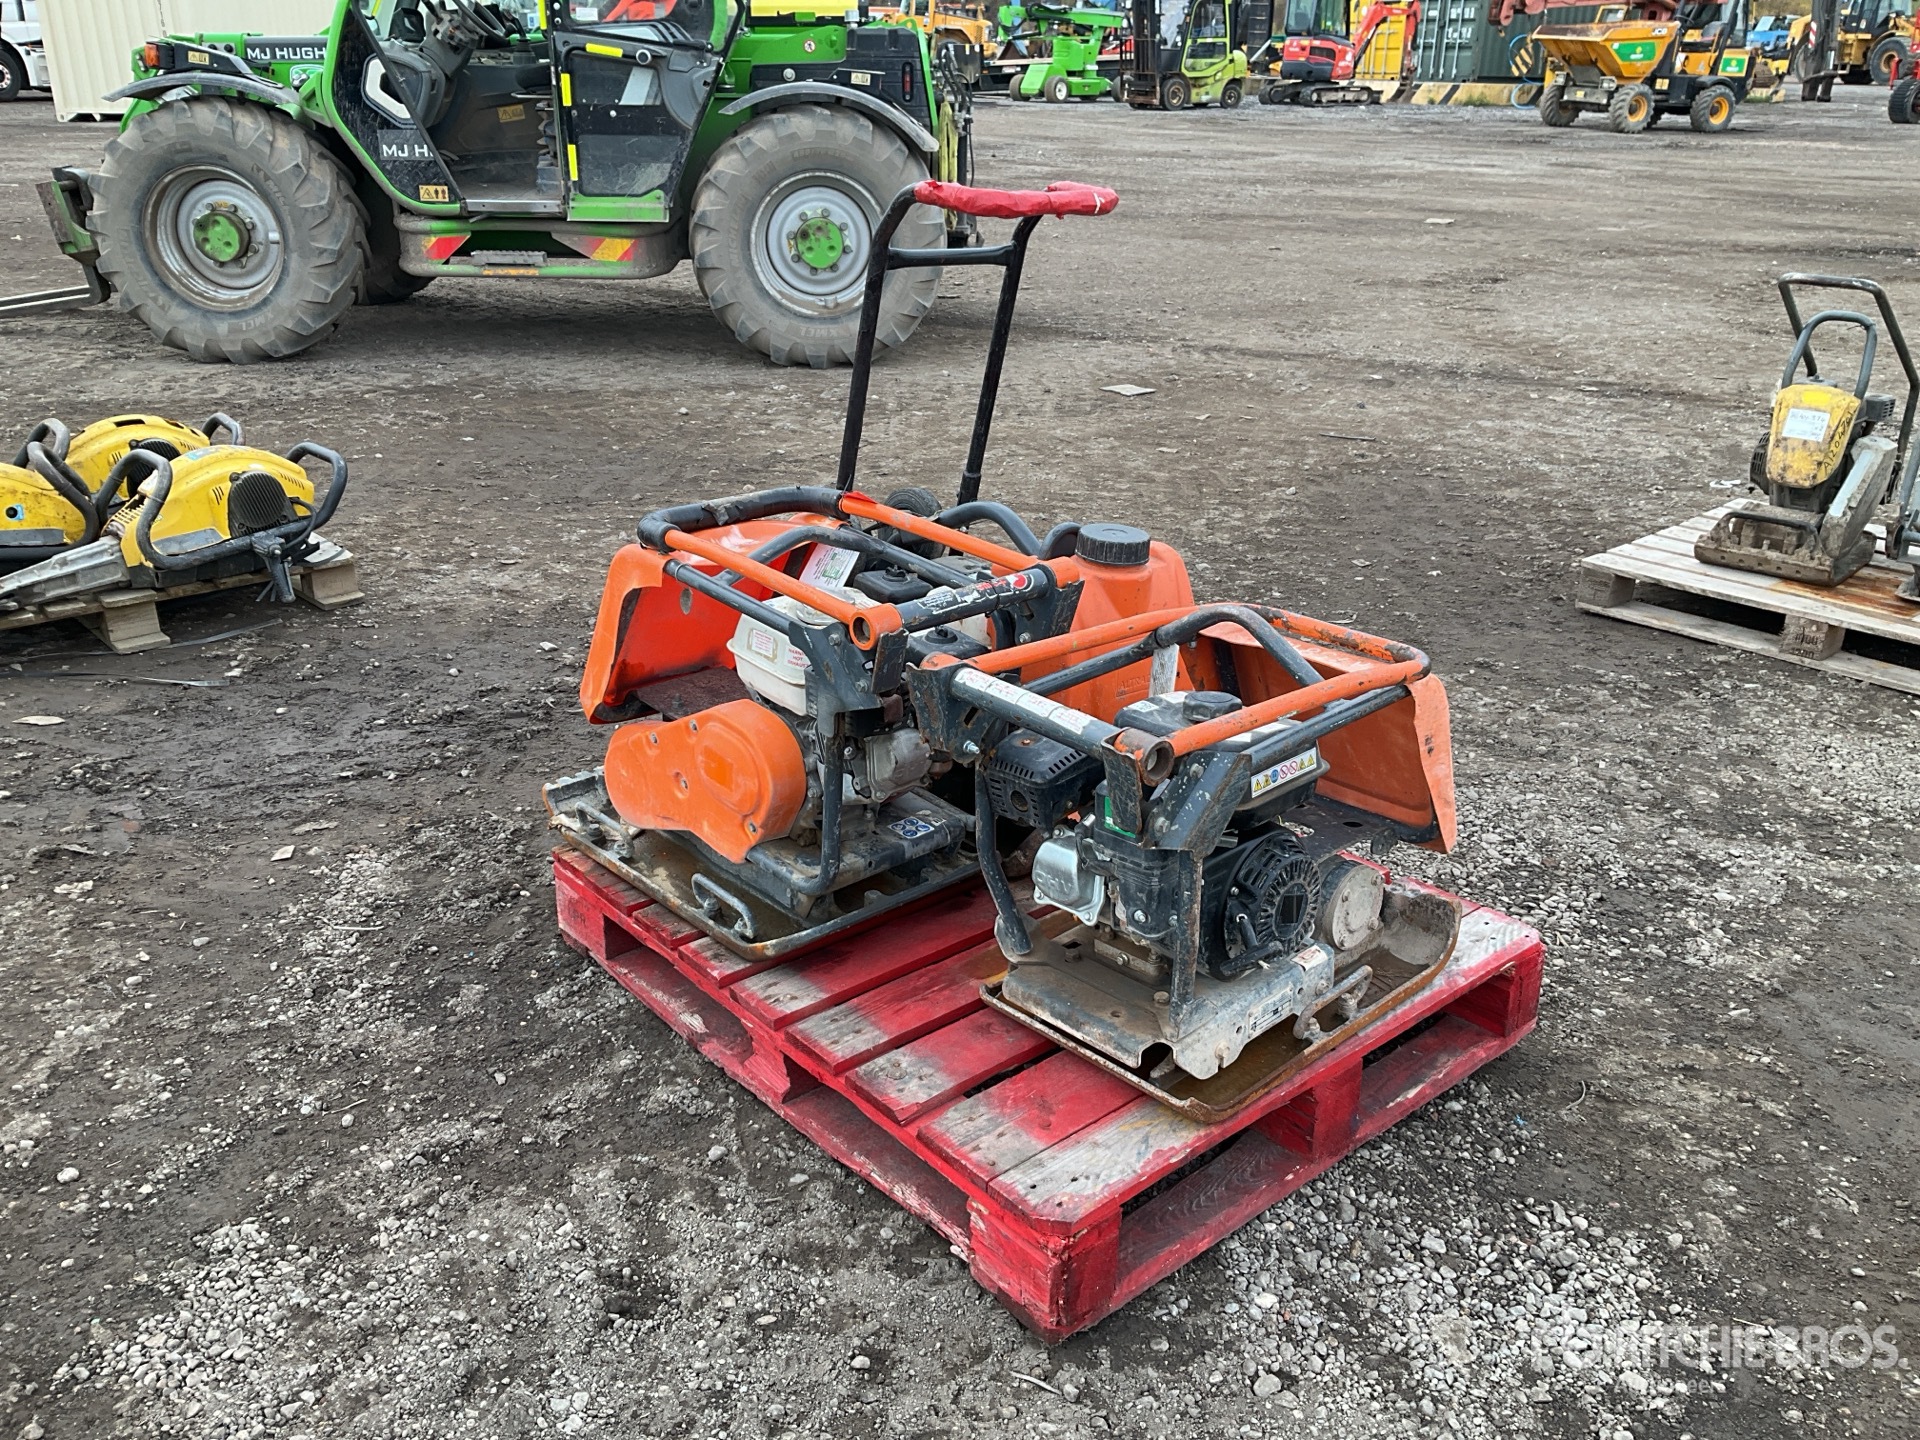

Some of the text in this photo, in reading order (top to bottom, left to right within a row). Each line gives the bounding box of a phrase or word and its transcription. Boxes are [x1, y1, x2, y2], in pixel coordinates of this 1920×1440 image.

[247, 47, 271, 59] MJ
[382, 144, 434, 157] MJ H
